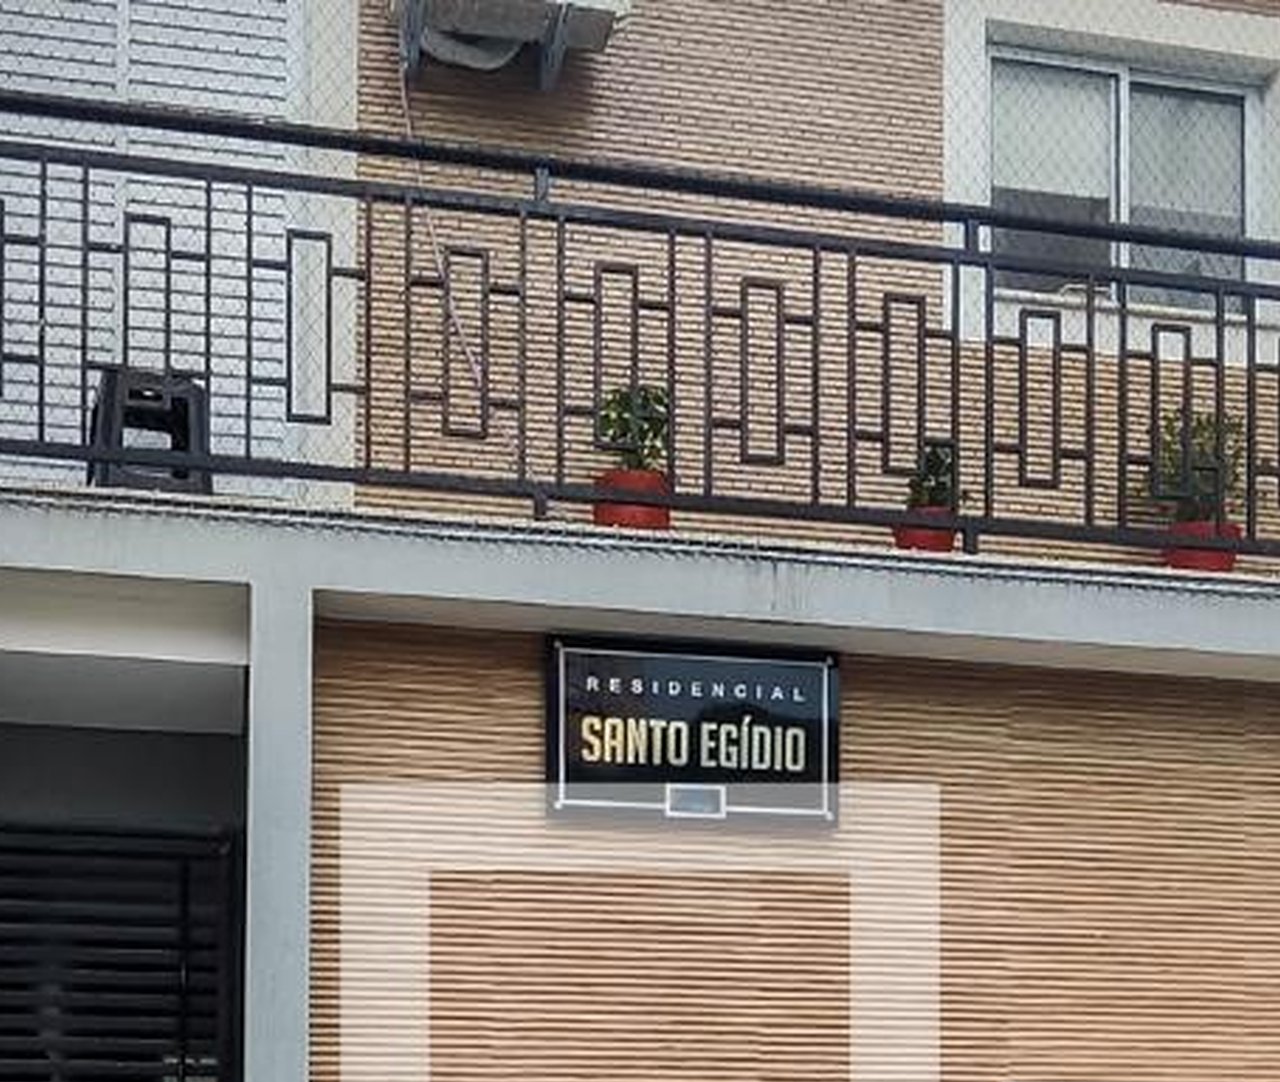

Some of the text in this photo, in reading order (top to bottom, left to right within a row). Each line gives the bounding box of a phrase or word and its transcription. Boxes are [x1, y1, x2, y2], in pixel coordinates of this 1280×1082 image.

[586, 676, 807, 702] RESIDENCIAL
[581, 714, 807, 772] SANTO EGÍDIO
